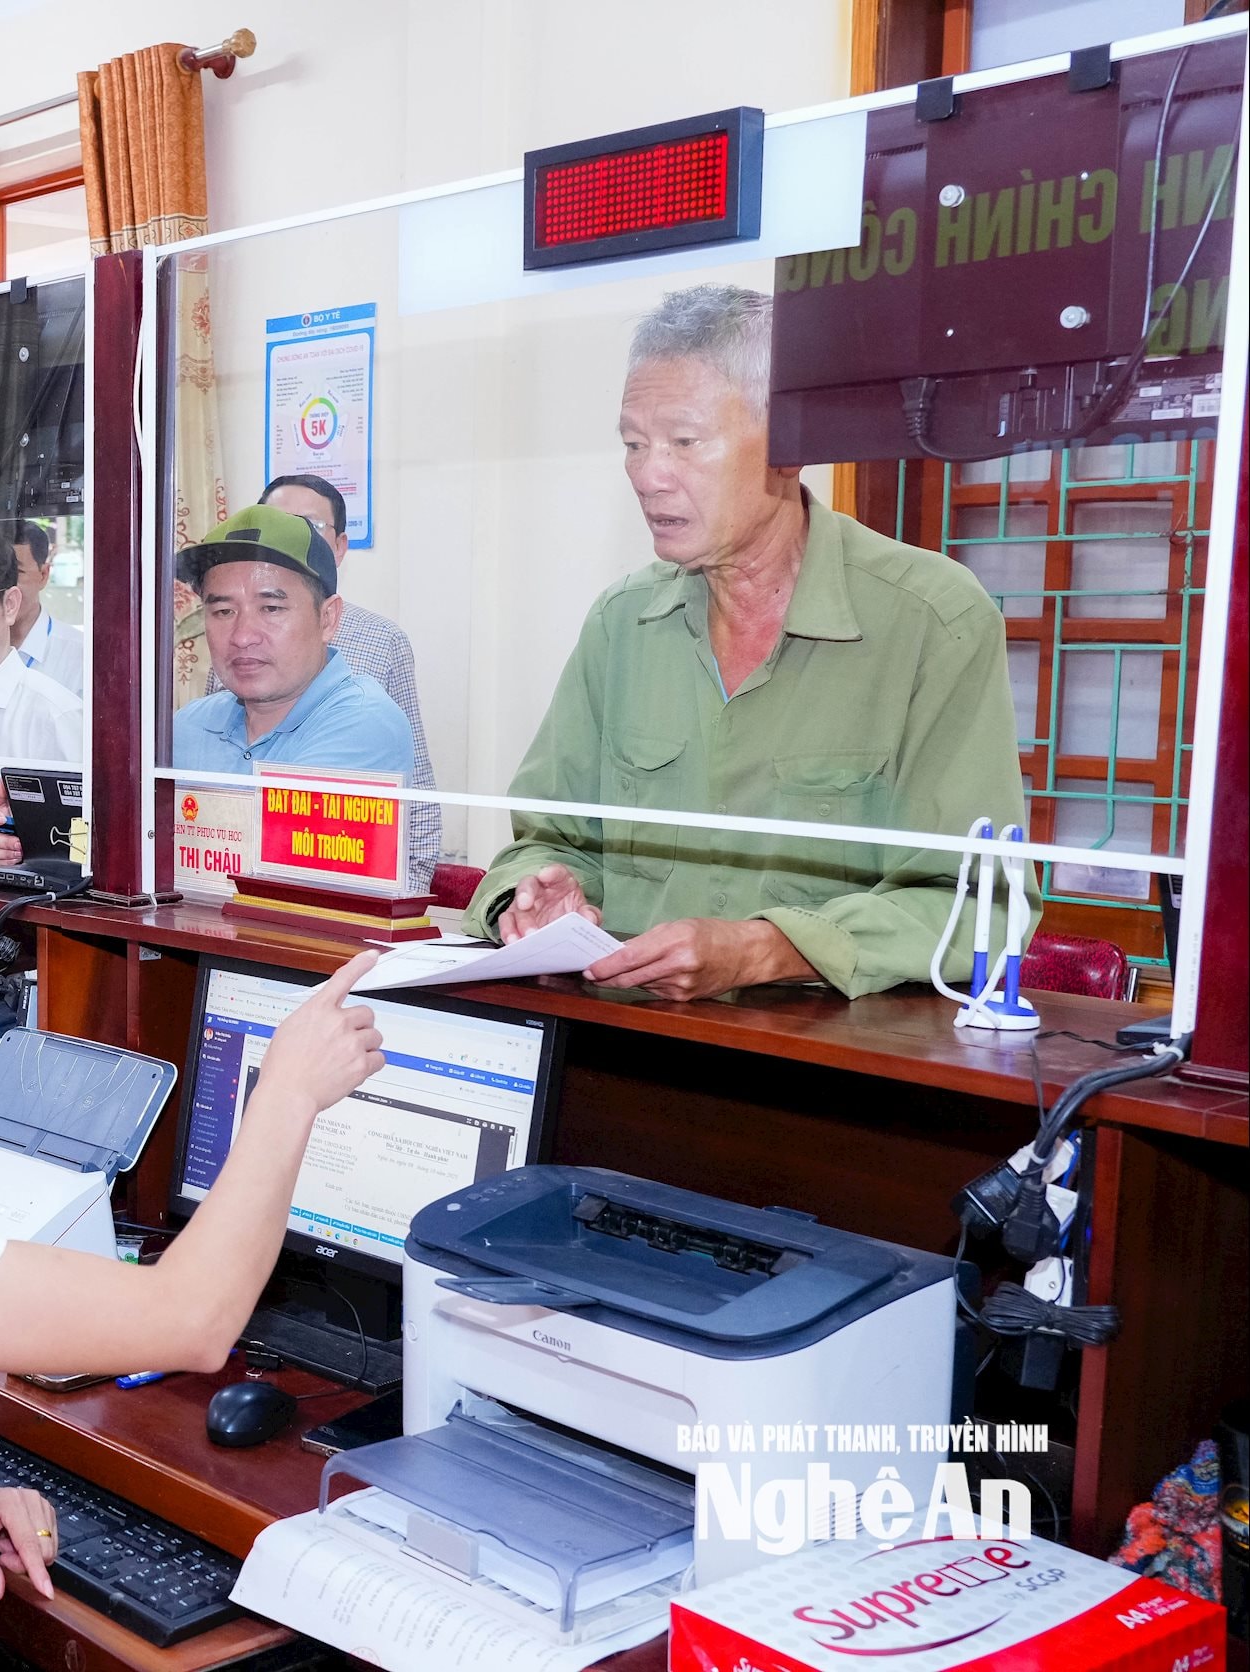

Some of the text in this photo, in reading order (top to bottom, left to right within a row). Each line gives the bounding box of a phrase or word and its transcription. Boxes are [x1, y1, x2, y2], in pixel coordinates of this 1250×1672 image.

[311, 419, 326, 437] 5K
[187, 825, 195, 836] TT
[197, 826, 215, 840] PHỤC
[216, 829, 226, 842] VỤ
[228, 830, 242, 842] HCC
[291, 827, 364, 864] MÔI TRƯỜNG
[179, 846, 241, 874] THỊ CHÂU
[315, 1245, 338, 1258] acer
[532, 1328, 571, 1351] Canon
[1015, 1567, 1066, 1592] SCGP
[1115, 1609, 1153, 1629] A4
